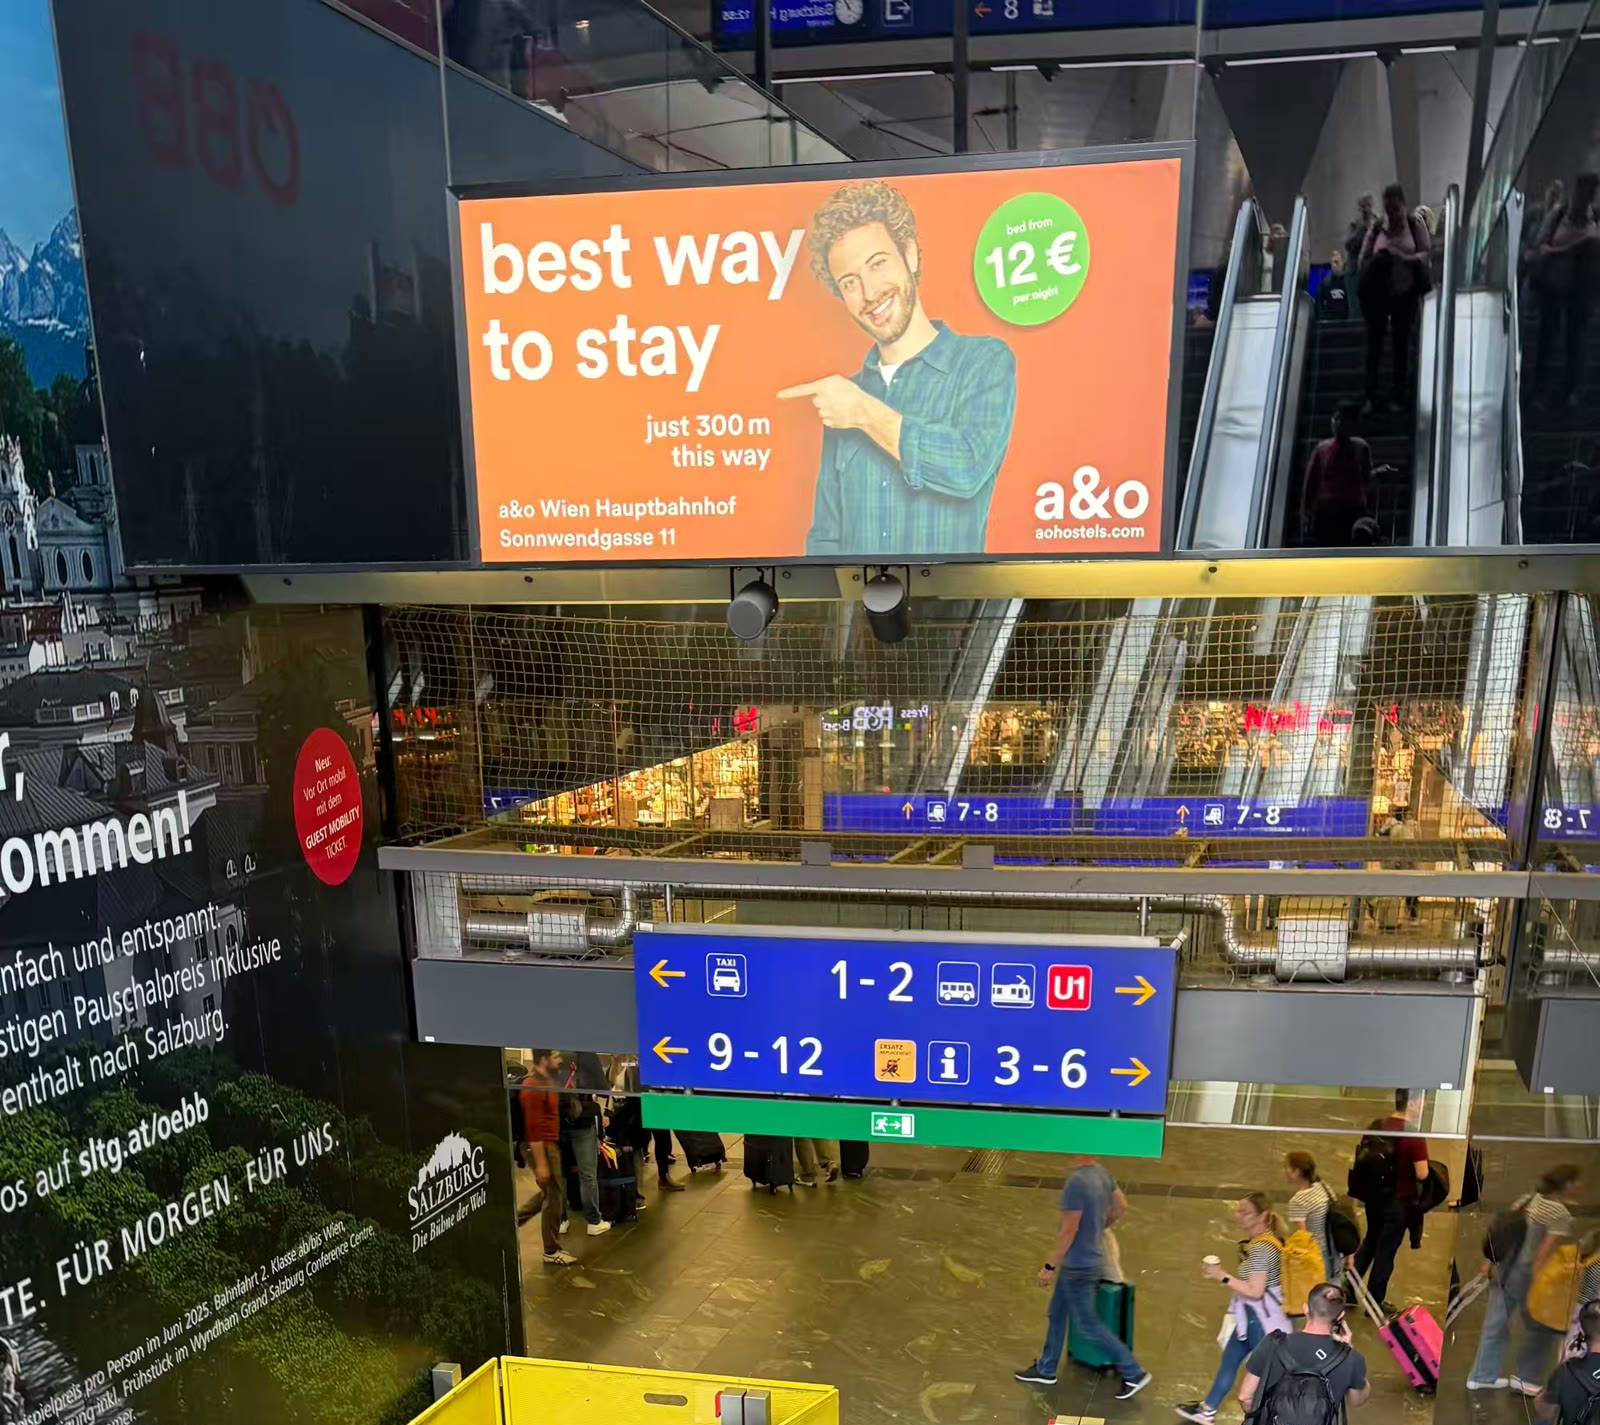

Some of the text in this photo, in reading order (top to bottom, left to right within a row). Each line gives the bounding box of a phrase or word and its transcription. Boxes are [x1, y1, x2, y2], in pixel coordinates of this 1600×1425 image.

[1006, 218, 1053, 235] bed from
[480, 222, 806, 300] best way
[985, 231, 1081, 288] 12 €
[1013, 285, 1059, 306] per night
[482, 314, 721, 392] to stay
[645, 414, 770, 444] just 300 m
[672, 443, 770, 471] this way
[499, 495, 736, 520] a&o Wien Hauptbahnhof
[1034, 465, 1149, 520] a&o
[500, 528, 675, 550] Sonnwendgasse 11
[1035, 524, 1144, 539] aohostels.com
[303, 766, 346, 801] Vor Ort mobil
[315, 756, 332, 773] Neu:
[305, 805, 360, 849] GUEST MOBILITY
[316, 793, 342, 817] mit dem
[0, 790, 192, 896] ommen!
[325, 835, 348, 859] TICKET.
[0, 902, 221, 996] nfach und entspannt:
[716, 958, 736, 967] TAXI
[74, 957, 205, 1029] Pauschalpreis
[210, 936, 281, 982] inklusive
[1054, 975, 1084, 1000] U1
[2, 1008, 229, 1116] enthalt nach Salzburg.
[36, 1148, 71, 1197] auf
[79, 1092, 209, 1177] sltg.at/oebb
[56, 1240, 113, 1296] FÜR
[121, 1174, 238, 1262] MORGEN.
[246, 1146, 287, 1193] FÜR
[293, 1121, 339, 1166] UNS.
[413, 1187, 486, 1254] Die Bühne der Welt
[84, 1370, 105, 1398] pro
[107, 1350, 145, 1379] Person
[147, 1334, 161, 1354] im
[163, 1321, 183, 1345] Juni
[185, 1301, 212, 1330] 2025.
[214, 1271, 259, 1310] Bahnfahrt
[260, 1265, 270, 1282] 2.
[270, 1250, 297, 1274] Klasse
[298, 1230, 323, 1258] ab/bis
[323, 1220, 346, 1241] Wien,
[96, 1391, 121, 1417] inkl.
[122, 1353, 174, 1397] Frühstück
[176, 1344, 189, 1364] im
[189, 1312, 240, 1352] Wyndham
[240, 1289, 268, 1318] Grand
[269, 1270, 304, 1301] Salzburg
[306, 1240, 349, 1277] Conference
